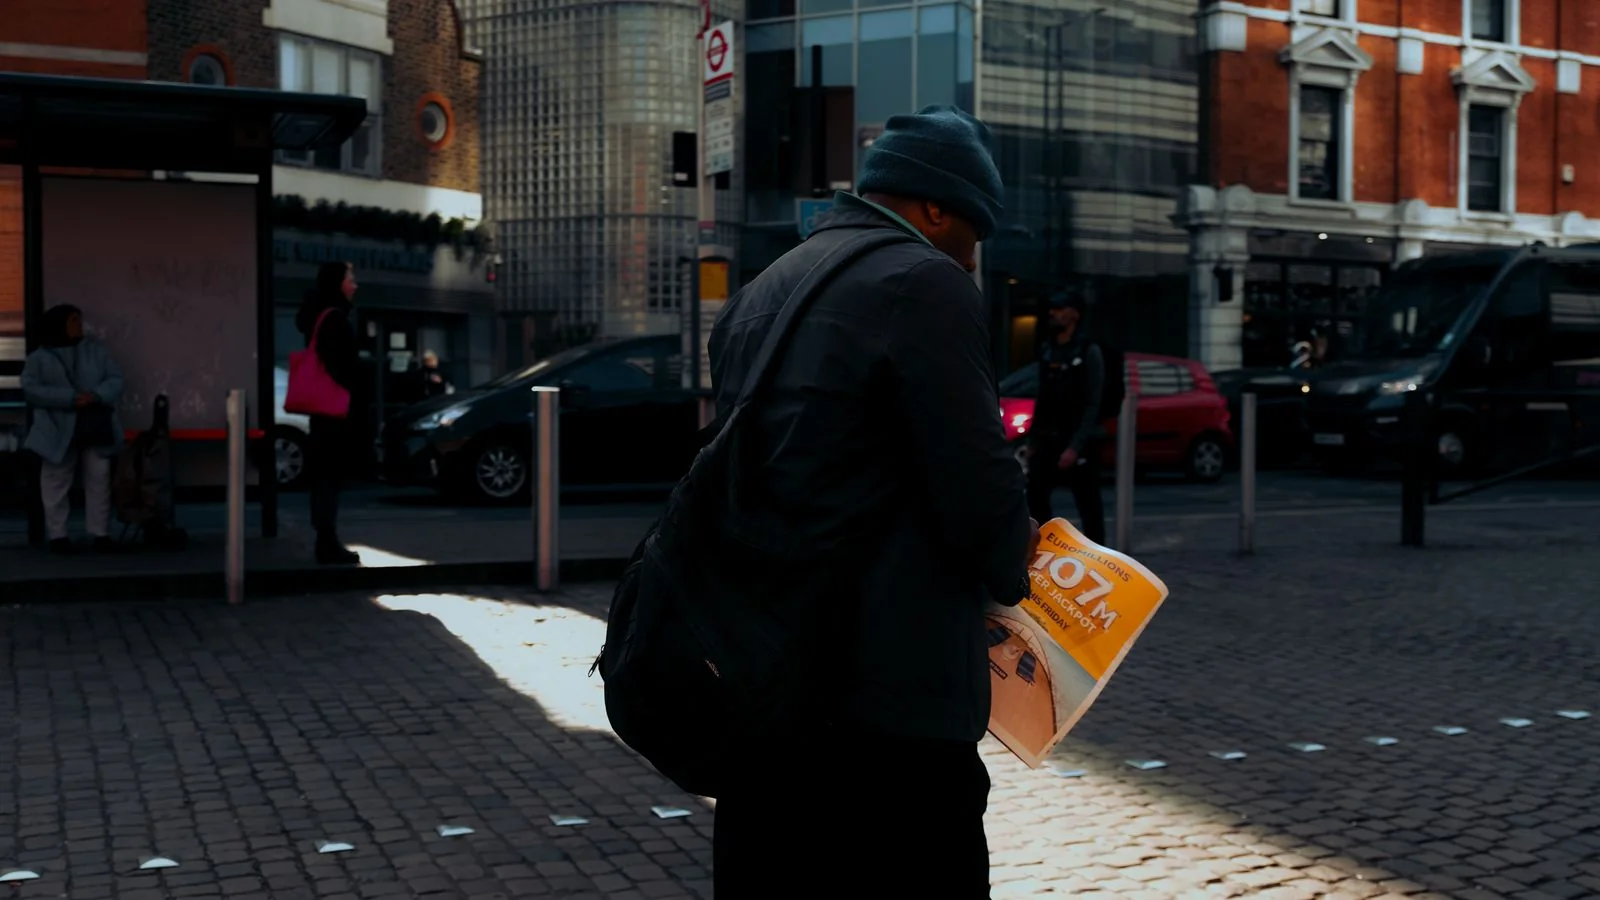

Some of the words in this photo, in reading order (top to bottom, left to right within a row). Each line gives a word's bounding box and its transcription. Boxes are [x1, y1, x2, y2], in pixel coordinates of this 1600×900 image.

[1046, 532, 1132, 583] EUROMILLIONS
[1027, 569, 1051, 591] PER
[1048, 585, 1097, 634] JACKPOT
[1040, 602, 1070, 630] FRIDAY
